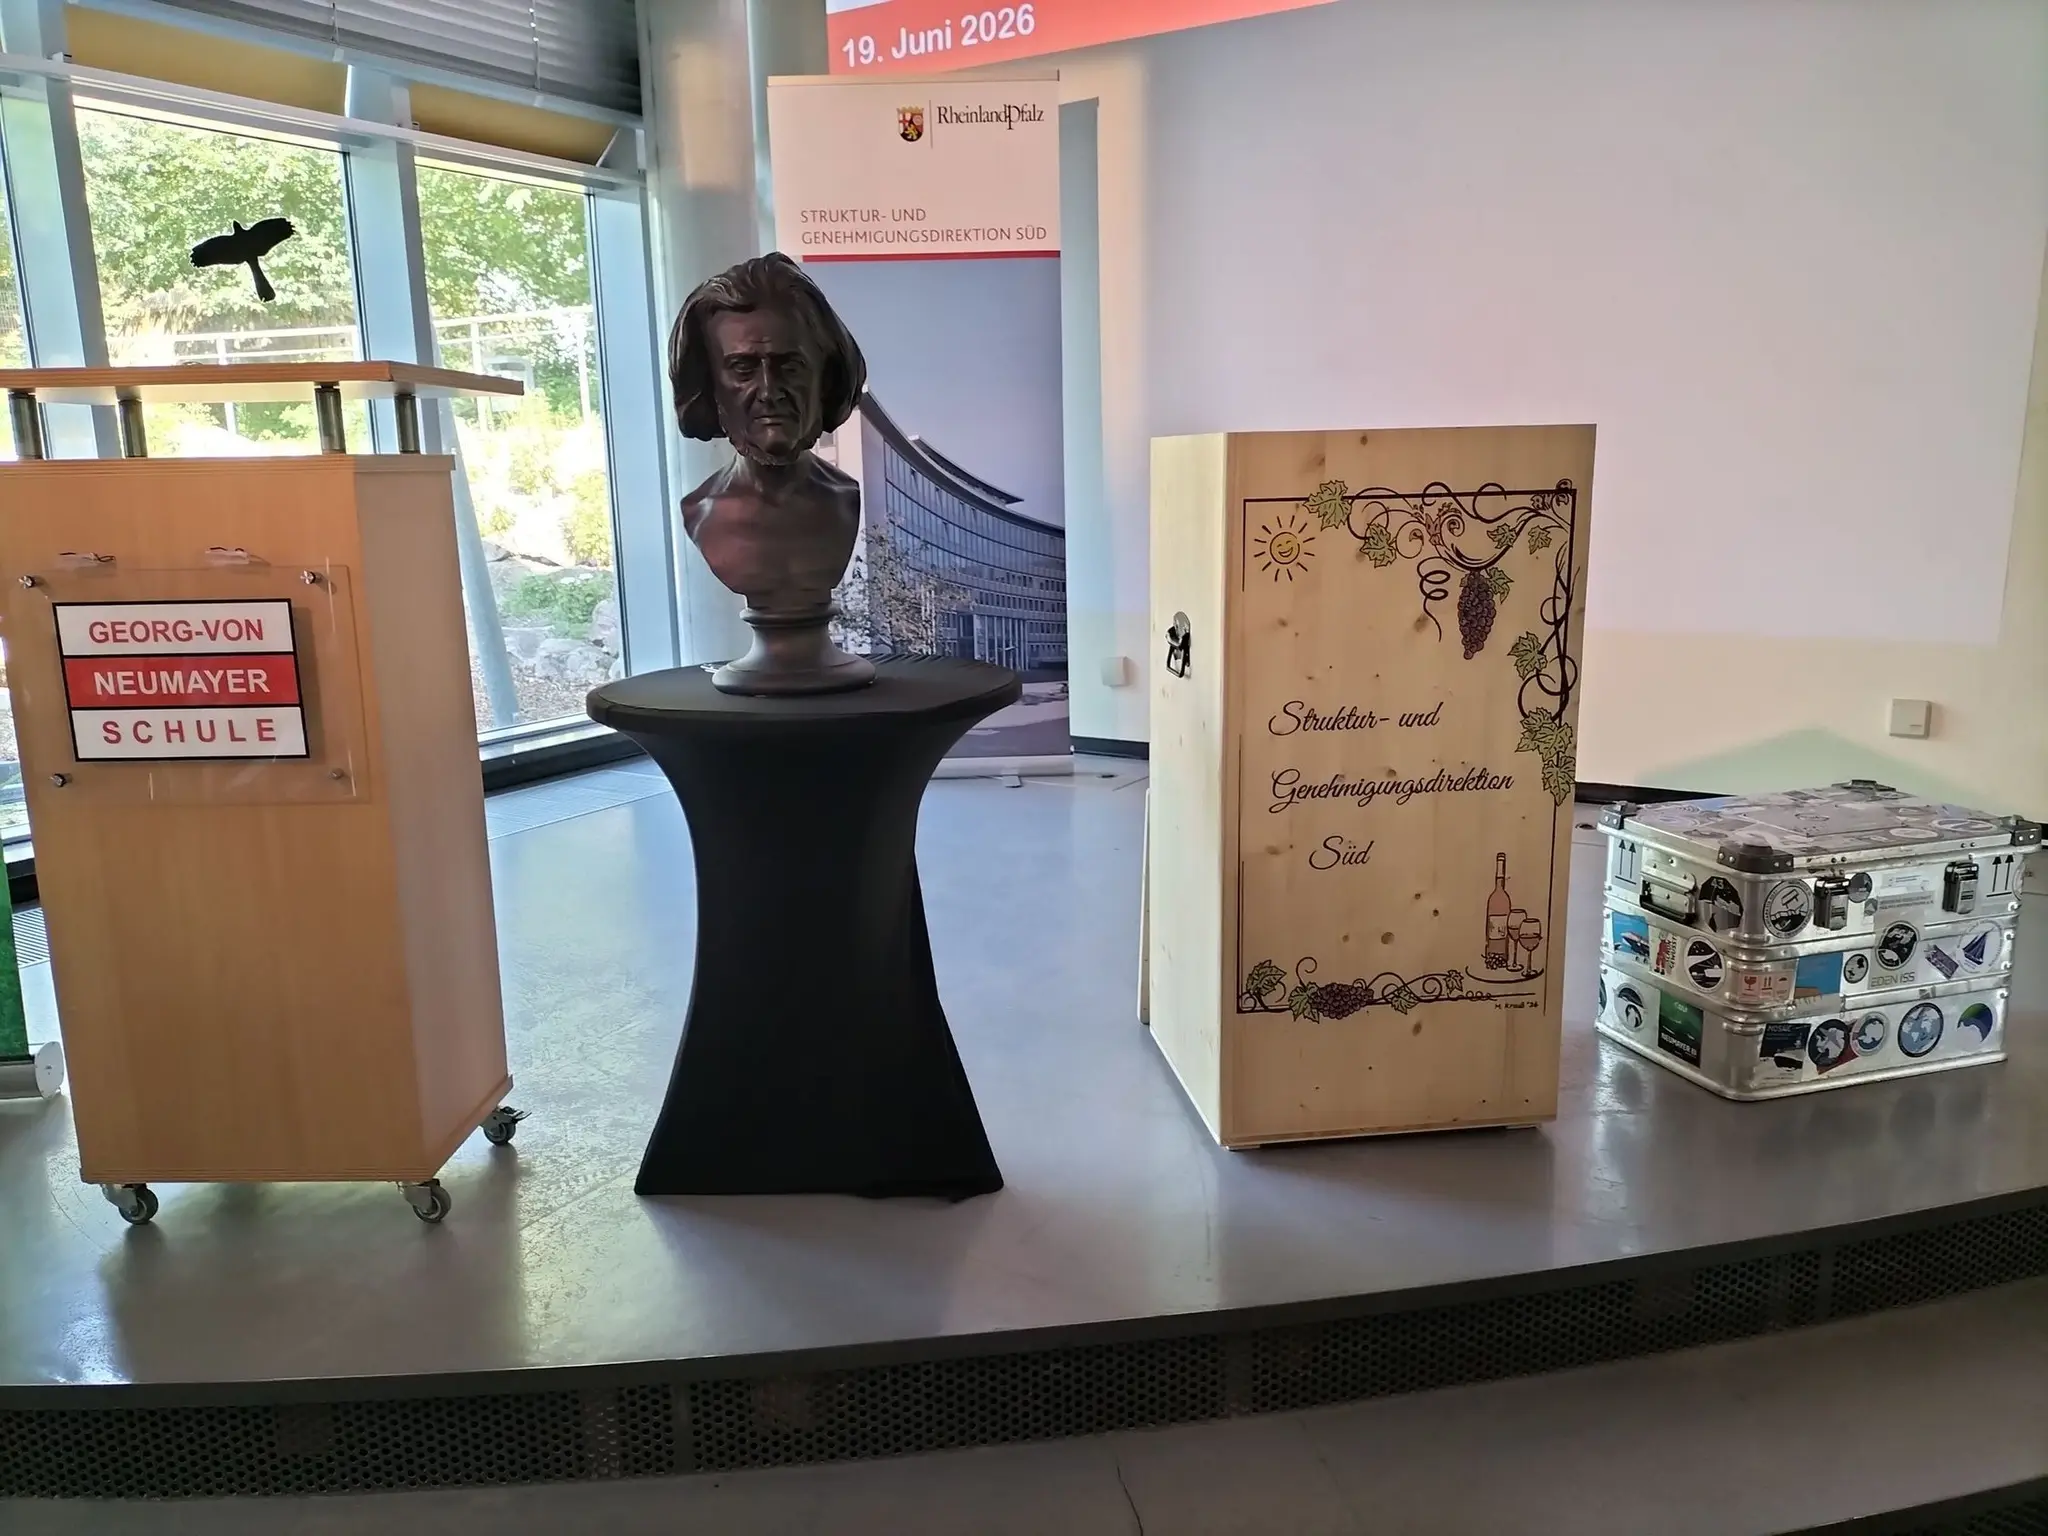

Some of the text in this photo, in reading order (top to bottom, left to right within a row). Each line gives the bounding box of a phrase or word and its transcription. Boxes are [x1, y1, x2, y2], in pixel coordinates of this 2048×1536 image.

[842, 3, 1036, 68] 19. Juni 2026
[800, 208, 927, 224] STRUKTUR- UND
[801, 224, 1047, 244] GENEHMIGUNGSDIREKTION SÜD
[88, 618, 264, 644] GEORG-VON
[93, 668, 271, 696] NEUMAYER
[102, 718, 277, 744] SCHULE
[1268, 700, 1444, 736] Struktur- und
[1268, 767, 1515, 814] Genehmigungsdirektion
[1308, 835, 1375, 870] Süd
[1871, 971, 1916, 988] EDEN ISS
